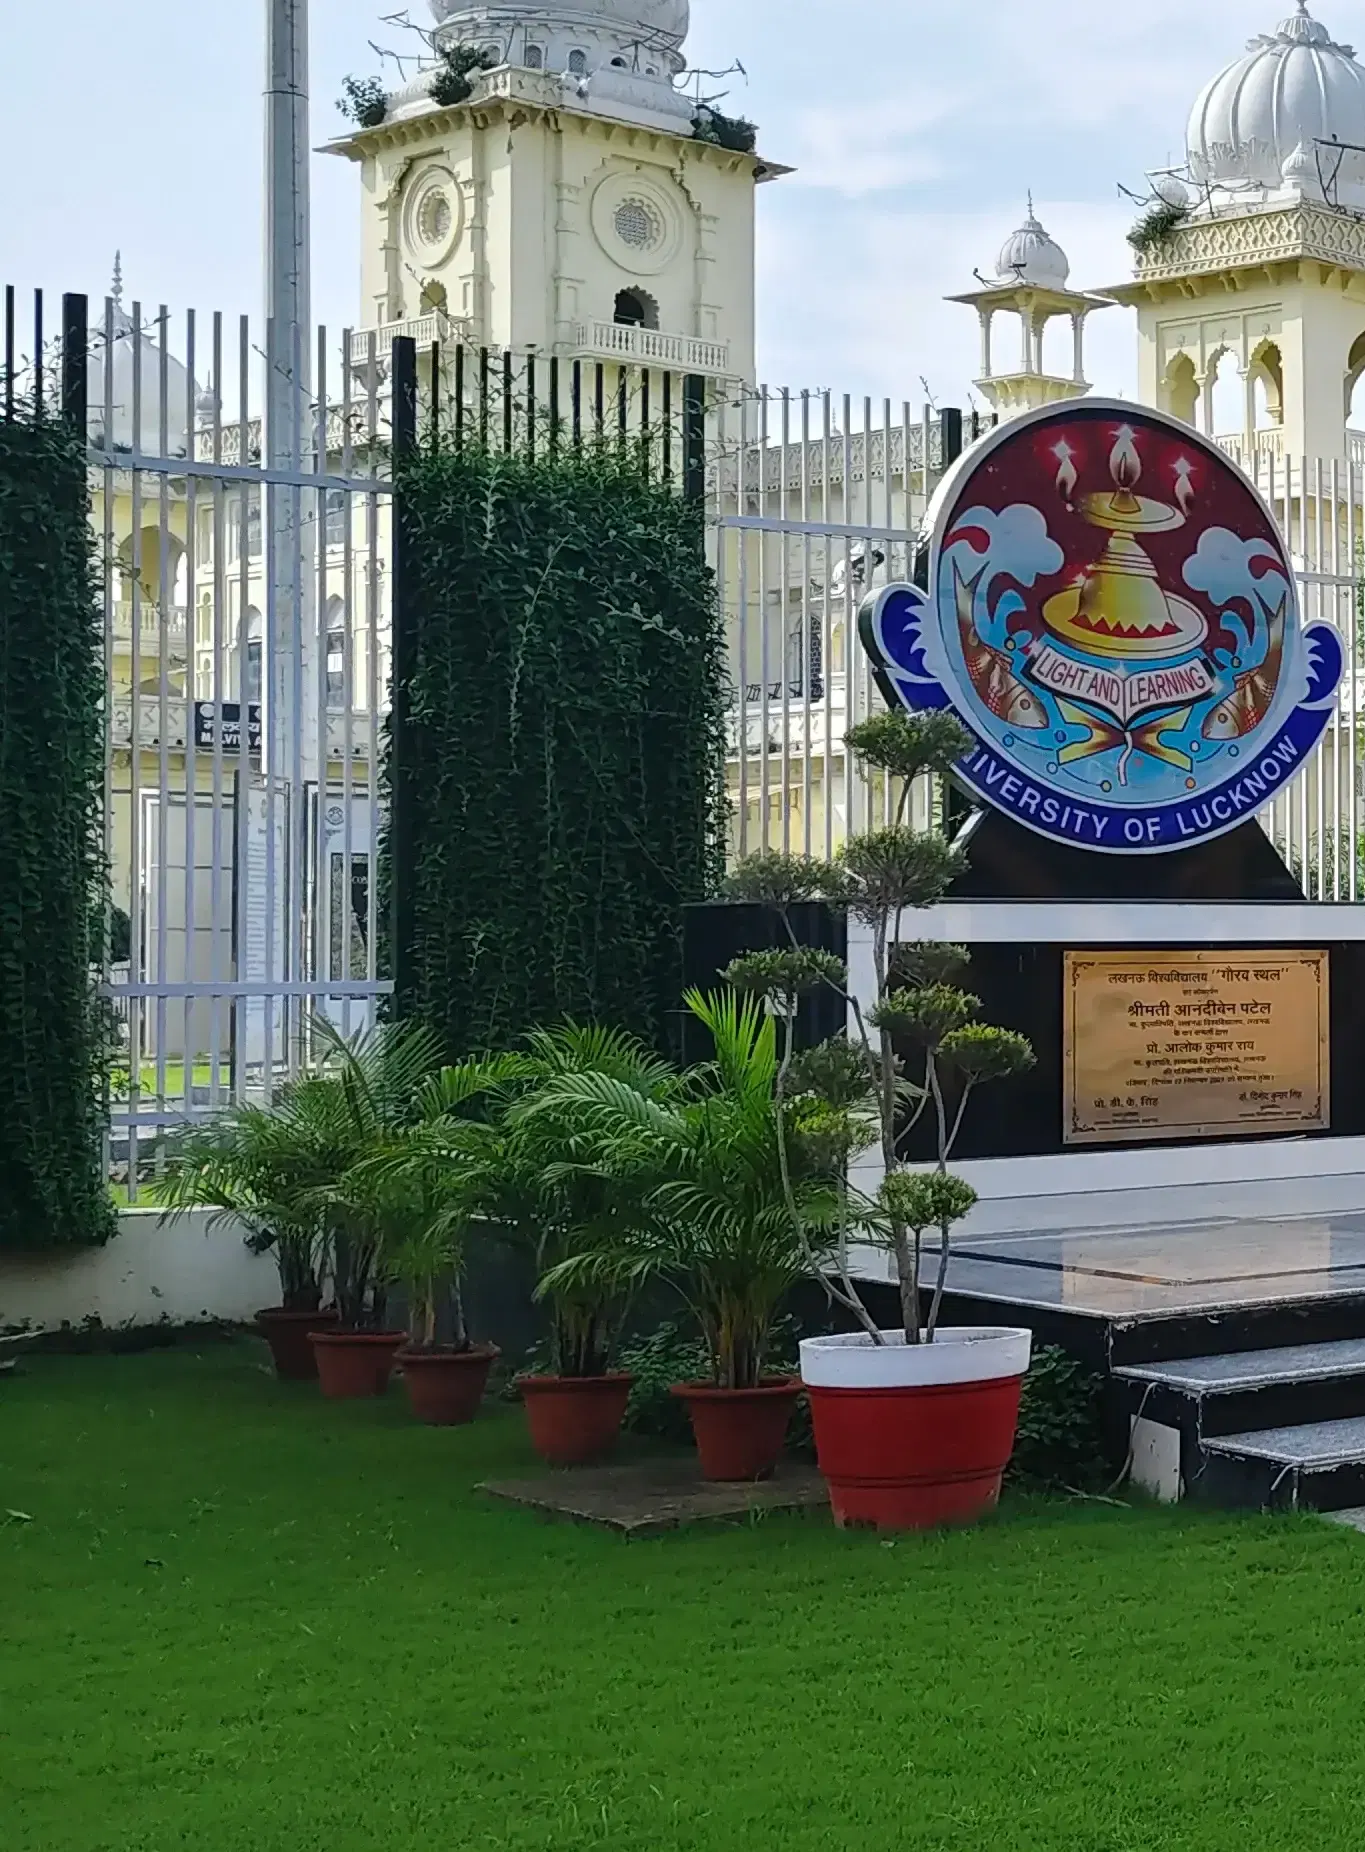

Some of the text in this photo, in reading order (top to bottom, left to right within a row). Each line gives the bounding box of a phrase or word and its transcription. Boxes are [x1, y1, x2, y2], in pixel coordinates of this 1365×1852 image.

[1037, 655, 1206, 707] LIGHT AND LEARNING
[1124, 817, 1161, 842] OF
[1175, 735, 1299, 835] LUCKNOW
[1108, 972, 1145, 984] लखनऊ
[1148, 970, 1208, 983] विश्वविद्यालय
[1127, 1000, 1170, 1016] श्रीमती
[1241, 998, 1271, 1014] पटेल
[1146, 1040, 1255, 1055] प्रो. आलोक कुमार राय
